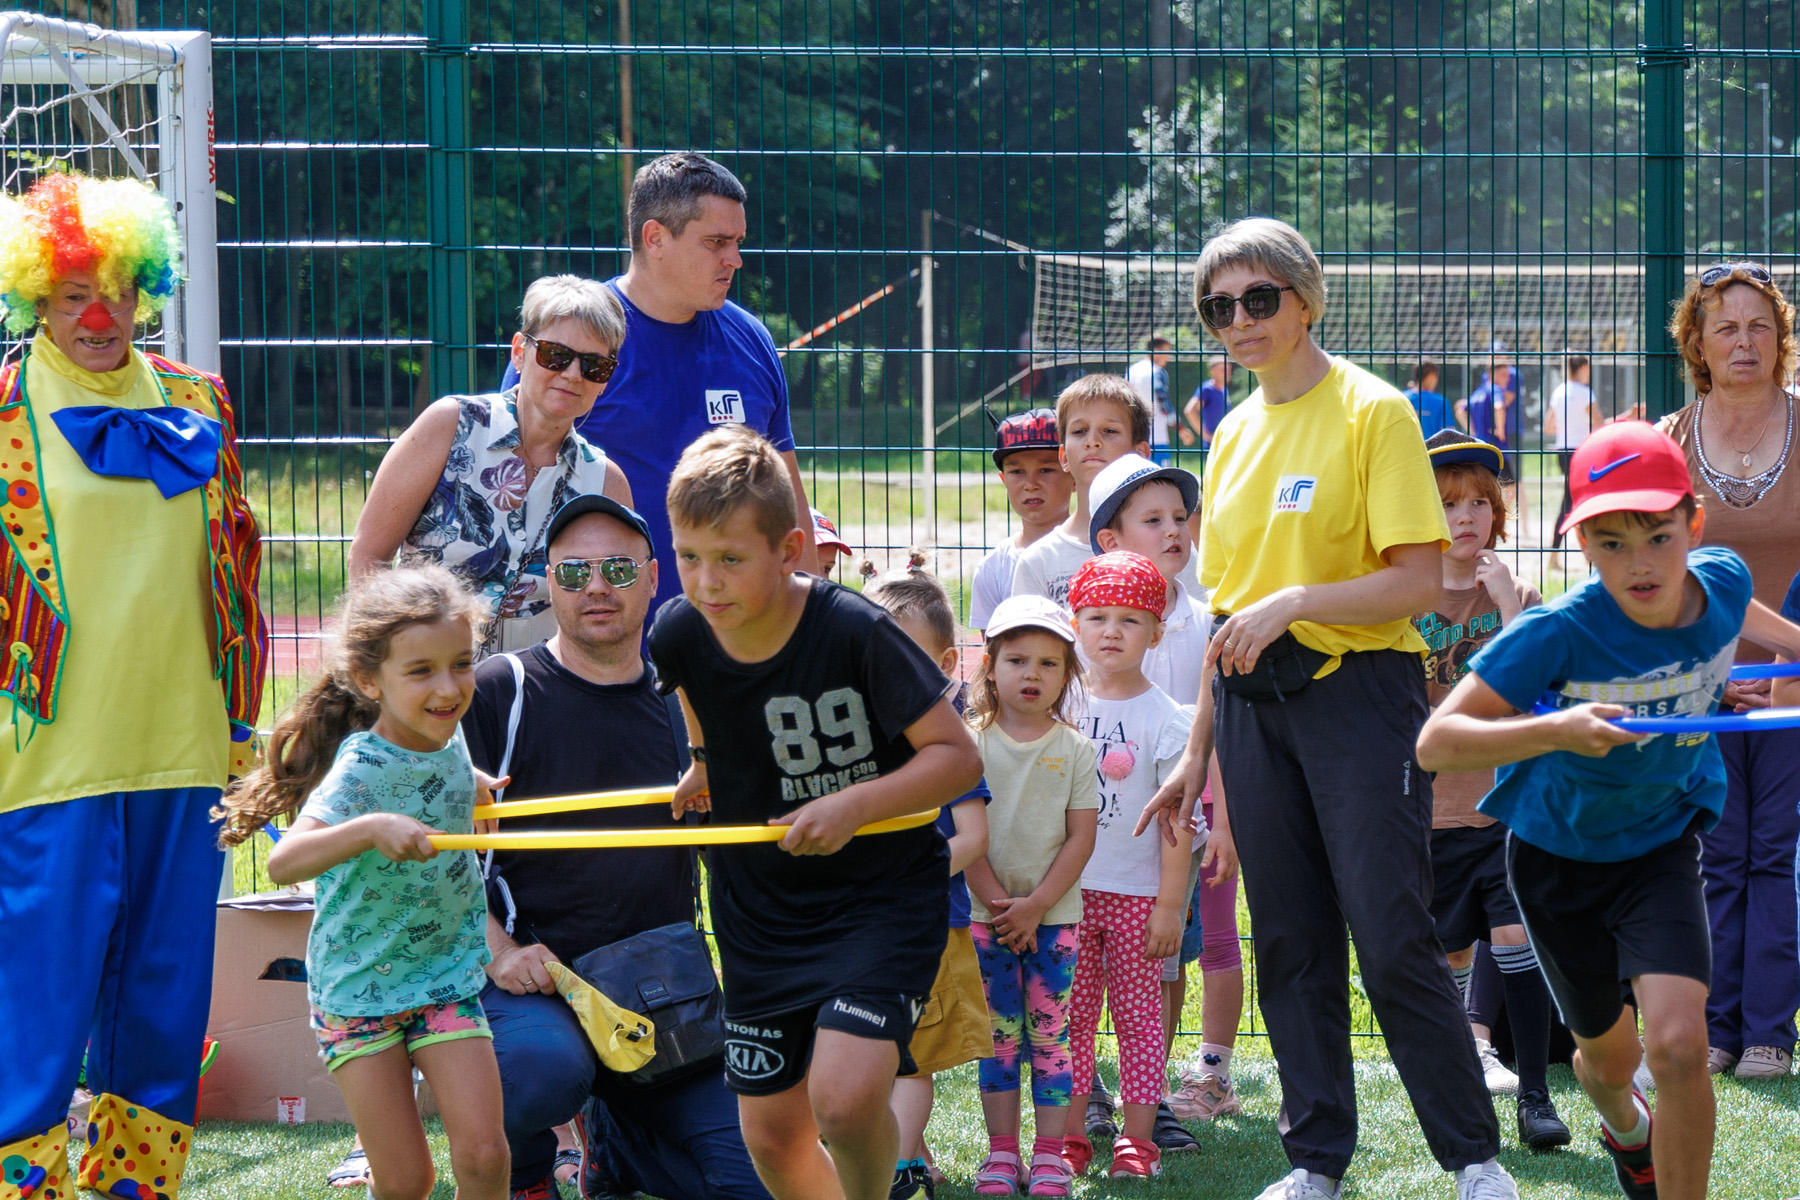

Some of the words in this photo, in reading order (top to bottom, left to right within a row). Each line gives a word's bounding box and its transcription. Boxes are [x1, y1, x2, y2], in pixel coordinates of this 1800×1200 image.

[1562, 674, 1694, 701] ABSTRACT
[764, 686, 874, 776] 89
[781, 768, 855, 800] BLACK
[833, 999, 887, 1028] hummel
[725, 1021, 759, 1037] ETON
[761, 1027, 784, 1039] AS
[728, 1044, 772, 1071] KIA
